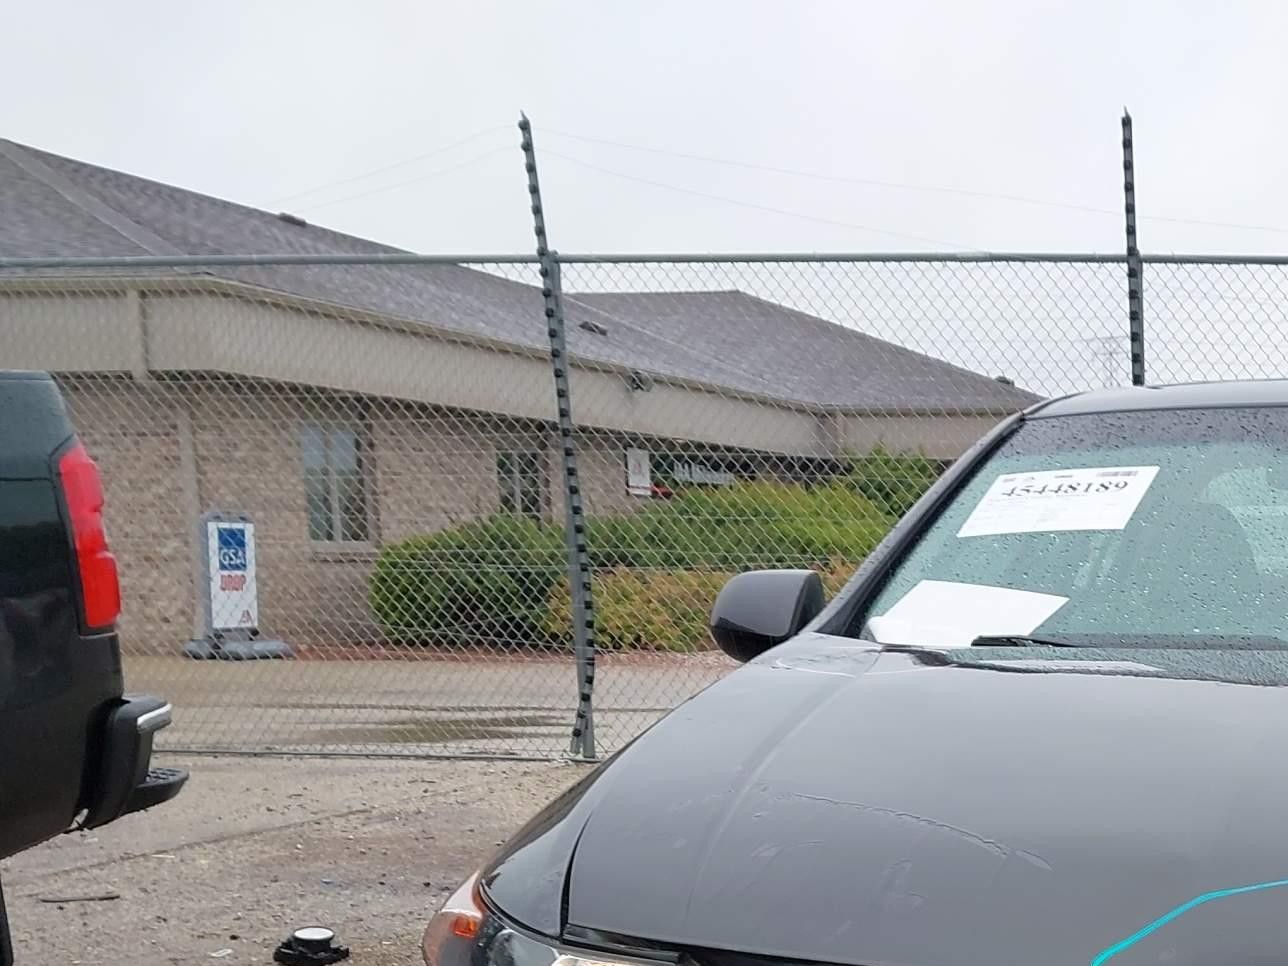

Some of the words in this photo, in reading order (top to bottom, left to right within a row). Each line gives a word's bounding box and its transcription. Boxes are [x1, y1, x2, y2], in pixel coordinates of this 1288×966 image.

[1001, 480, 1128, 497] 45448189
[220, 548, 246, 564] GSA
[220, 574, 247, 592] DROP
